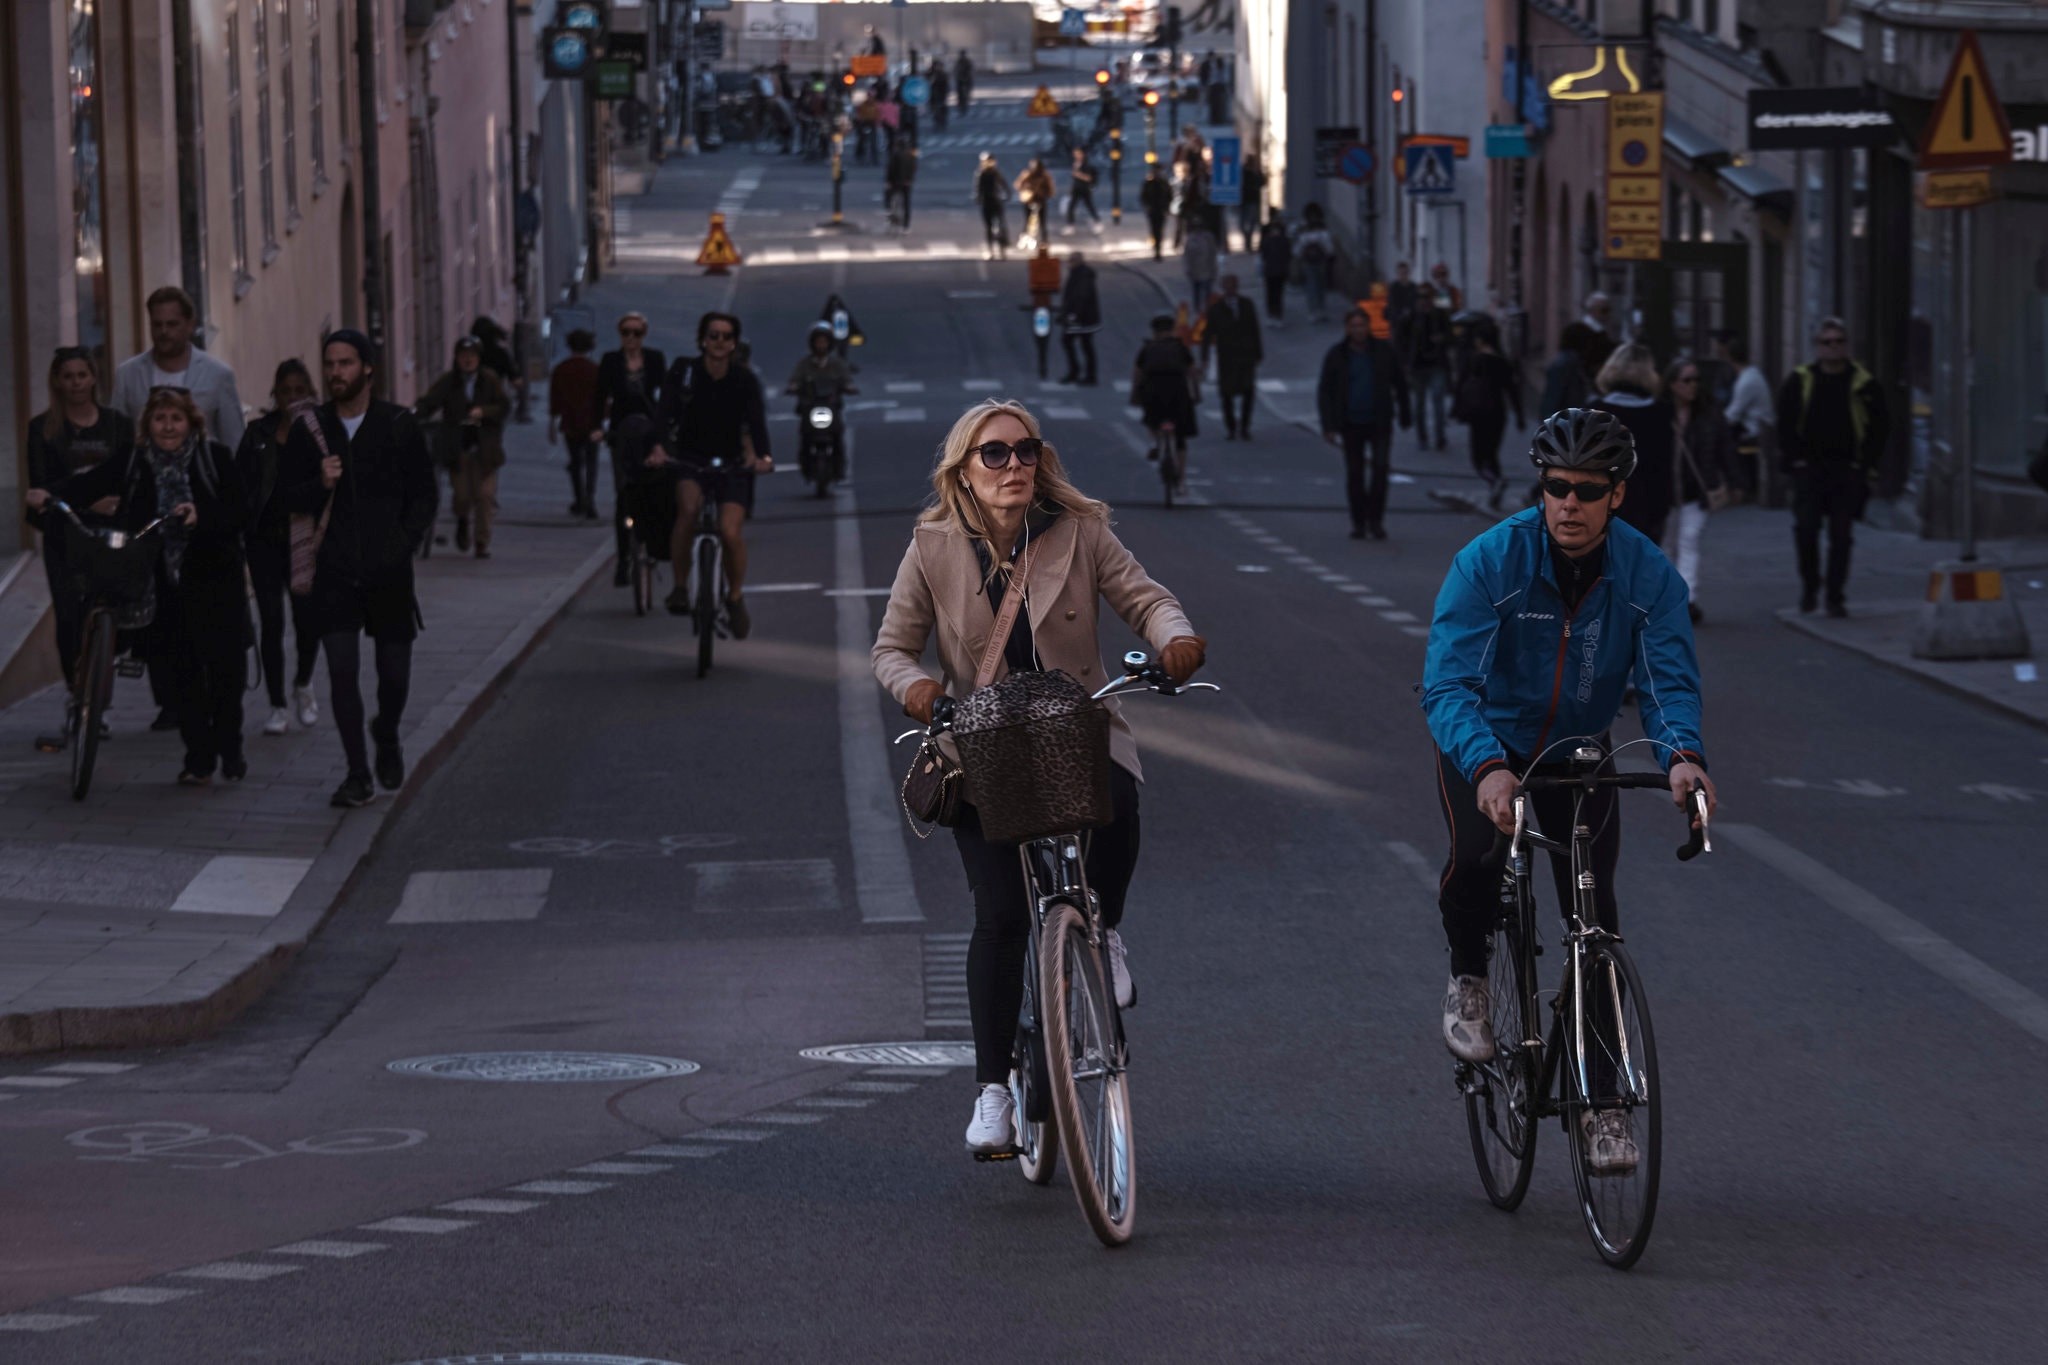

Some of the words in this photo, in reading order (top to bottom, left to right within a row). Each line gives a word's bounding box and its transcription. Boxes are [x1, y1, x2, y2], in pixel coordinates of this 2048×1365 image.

[995, 615, 1010, 640] LOUIS
[982, 641, 1000, 675] VUITTON
[1577, 619, 1601, 703] 8848
